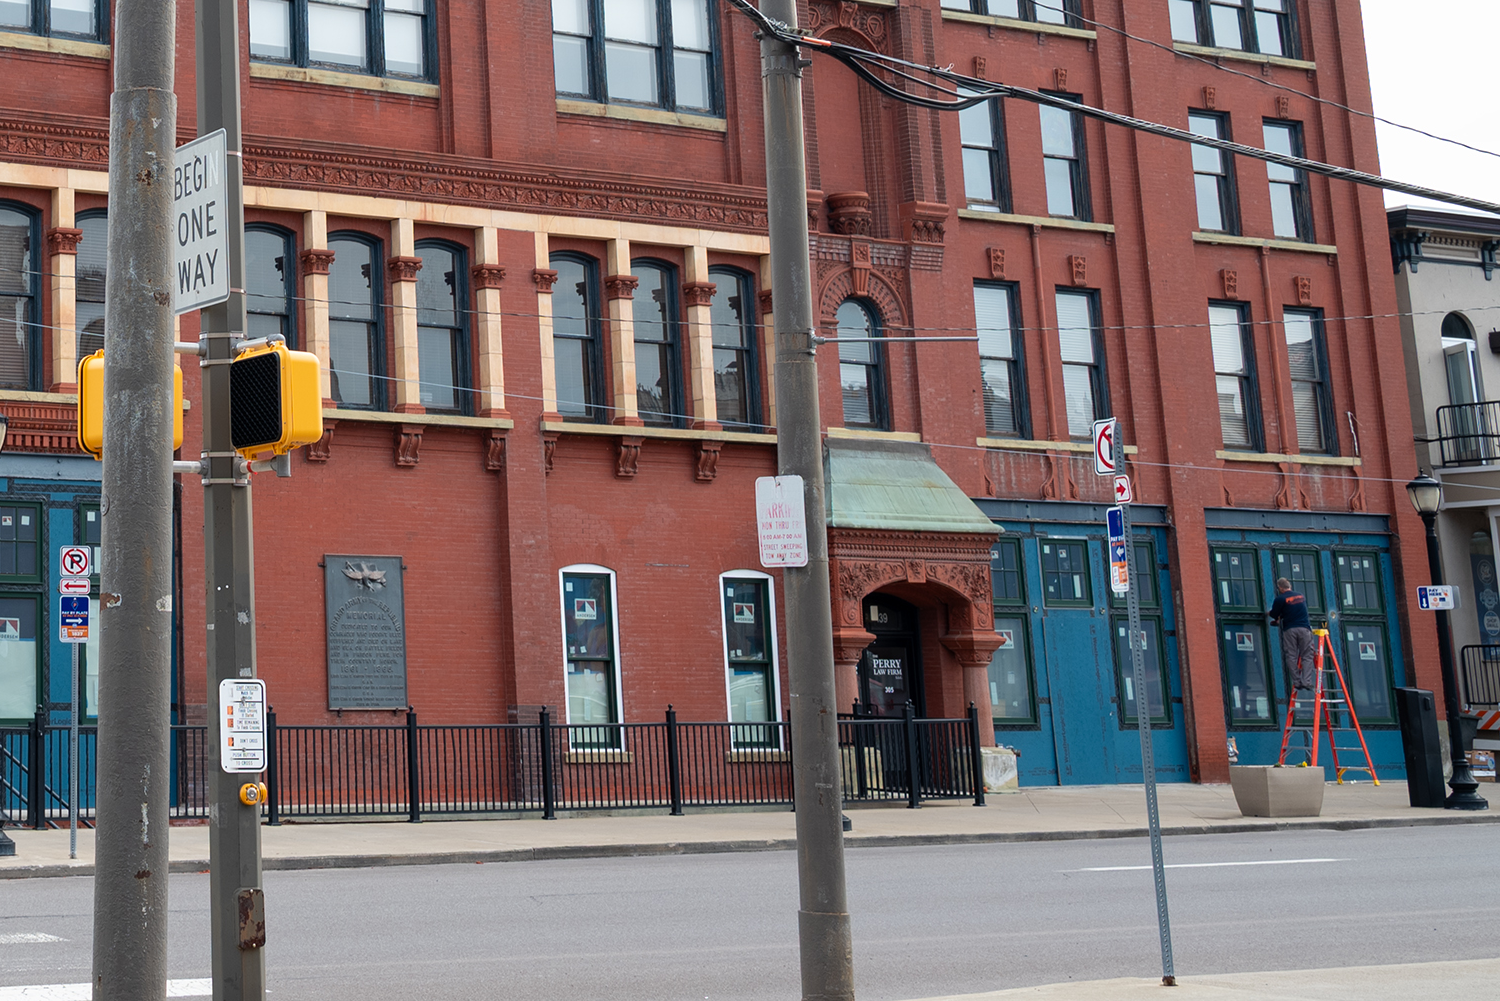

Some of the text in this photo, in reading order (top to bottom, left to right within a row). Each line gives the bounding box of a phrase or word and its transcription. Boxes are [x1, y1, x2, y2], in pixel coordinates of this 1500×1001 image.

[174, 150, 219, 201] BEGIN
[178, 201, 217, 247] ONE
[178, 248, 219, 295] WAY
[762, 521, 773, 530] MON
[775, 520, 789, 529] THRU
[346, 611, 386, 621] MEMORIAL
[873, 659, 901, 669] PERRY
